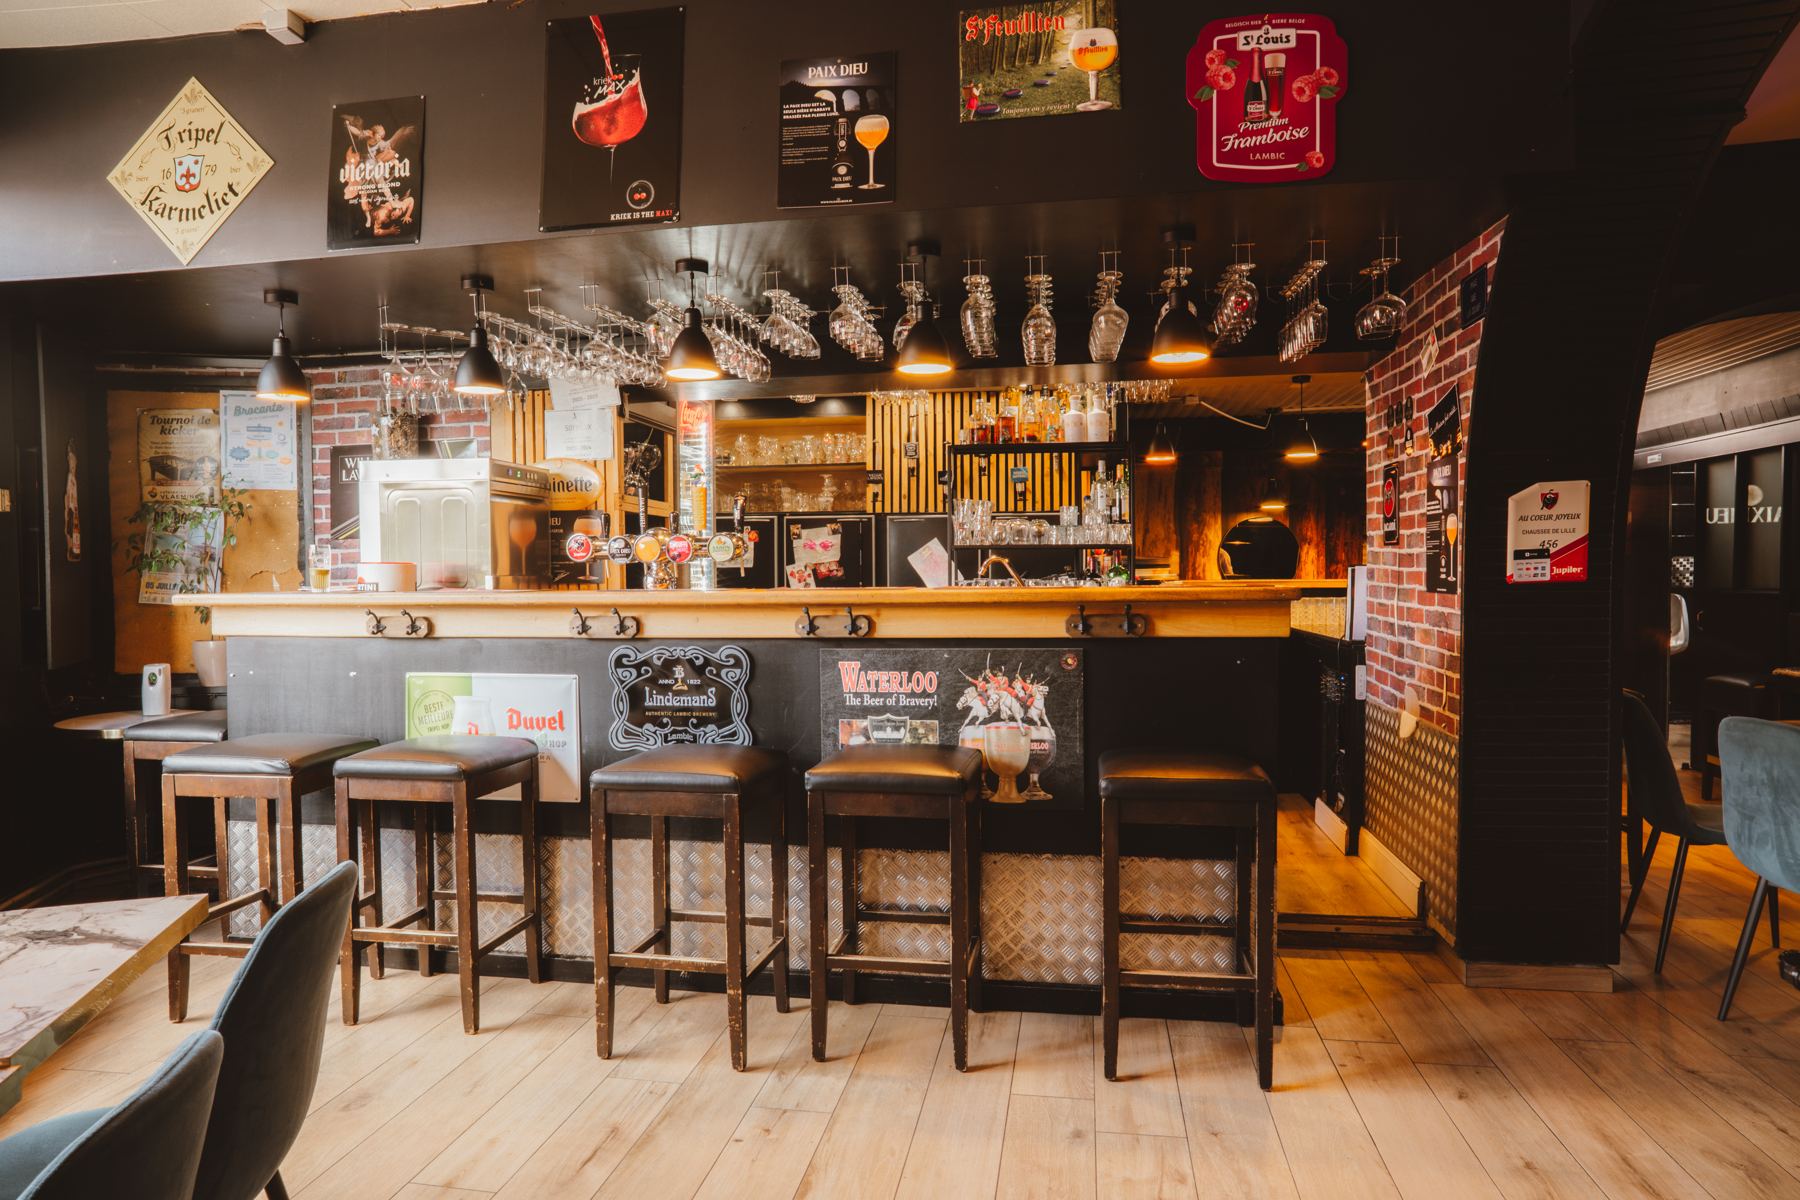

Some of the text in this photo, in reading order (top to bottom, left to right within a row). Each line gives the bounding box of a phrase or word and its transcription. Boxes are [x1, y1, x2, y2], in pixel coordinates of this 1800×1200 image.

[983, 11, 1065, 45] Feuillien
[1256, 33, 1291, 45] Louis
[808, 62, 868, 79] PAIX DIEU
[593, 76, 613, 86] kriek
[594, 80, 625, 99] MAX
[1238, 117, 1289, 133] Premium
[157, 118, 227, 153] Tripel
[1221, 126, 1310, 152] Framboise
[1250, 152, 1286, 160] LAMBIC
[161, 168, 172, 180] 16
[204, 164, 217, 176] 79
[339, 153, 411, 184] victoria
[140, 181, 240, 223] Karmeliet
[610, 213, 632, 221] KRIEK
[655, 209, 673, 217] MAX!
[233, 402, 285, 416] Brocante
[150, 415, 211, 425] Tournoi de
[549, 476, 593, 493] inette
[1530, 513, 1554, 521] COEUR
[1554, 512, 1582, 522] JOYEUX
[1539, 540, 1559, 549] 456
[1551, 566, 1583, 575] Jupiler
[423, 701, 445, 714] BESTE
[843, 693, 938, 710] The Beer of Bravery!
[505, 706, 566, 732] Duvel
[549, 740, 567, 748] HOP
[667, 732, 694, 741] Lambic
